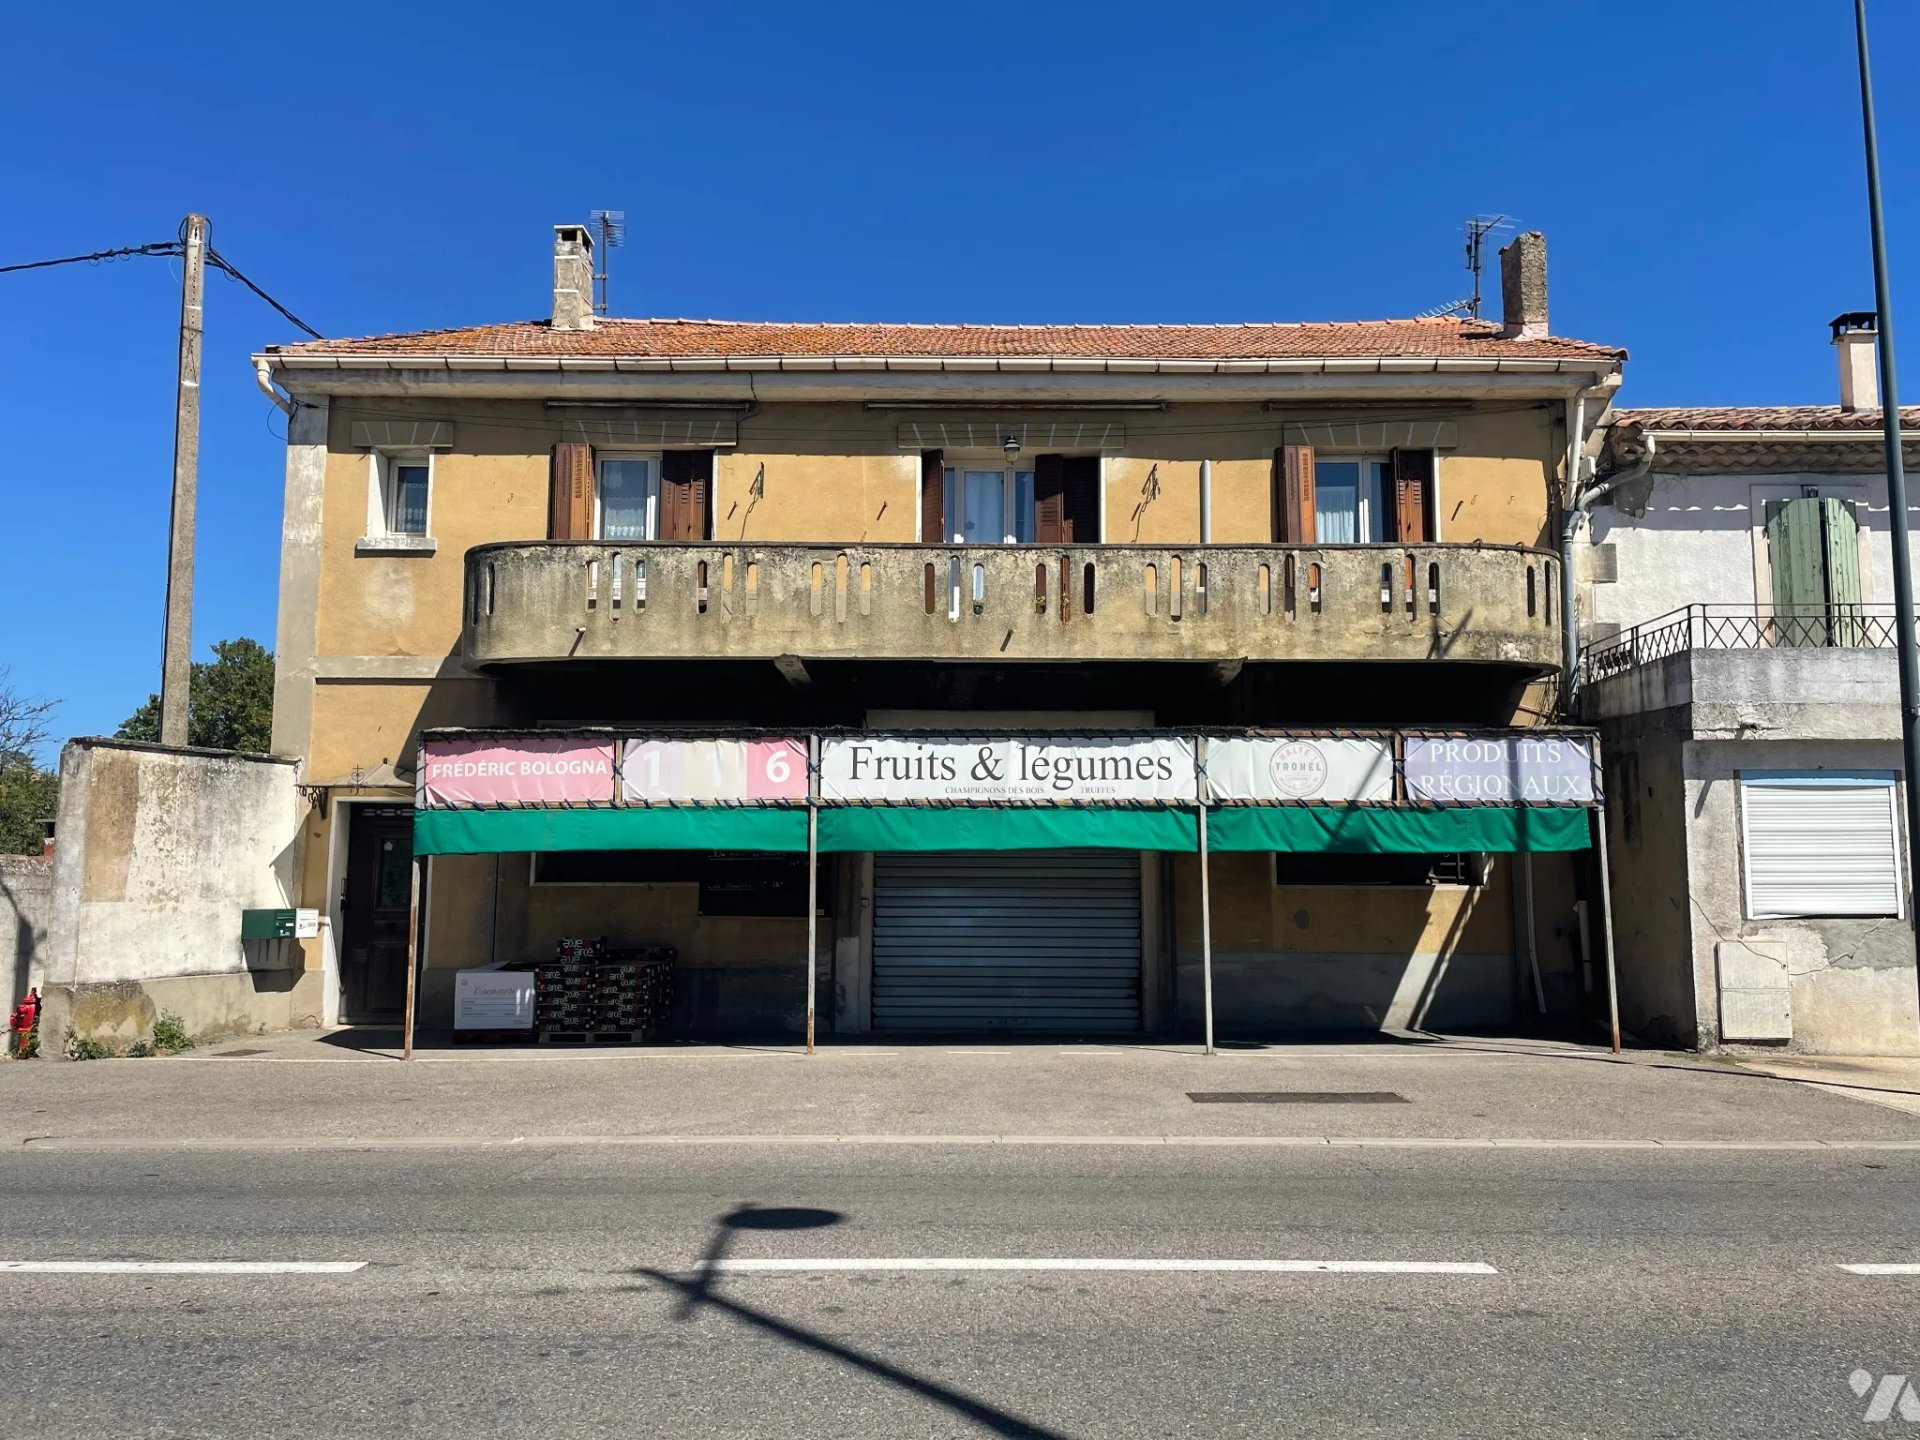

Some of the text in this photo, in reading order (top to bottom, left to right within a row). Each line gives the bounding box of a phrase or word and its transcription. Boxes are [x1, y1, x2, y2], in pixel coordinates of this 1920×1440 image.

[1430, 743, 1562, 763] PRODUITS
[432, 758, 607, 779] FRÉDÉRIC BOLOGNA
[643, 750, 661, 787] 1
[765, 750, 791, 783] 6
[849, 744, 1173, 791] Fruits & légumes
[1275, 762, 1322, 772] TRONEL
[944, 786, 1045, 795] CHAMPIGNONS DES BOIS
[1080, 786, 1116, 795] TRUFFES
[1421, 771, 1581, 796] RÉGIONAUX
